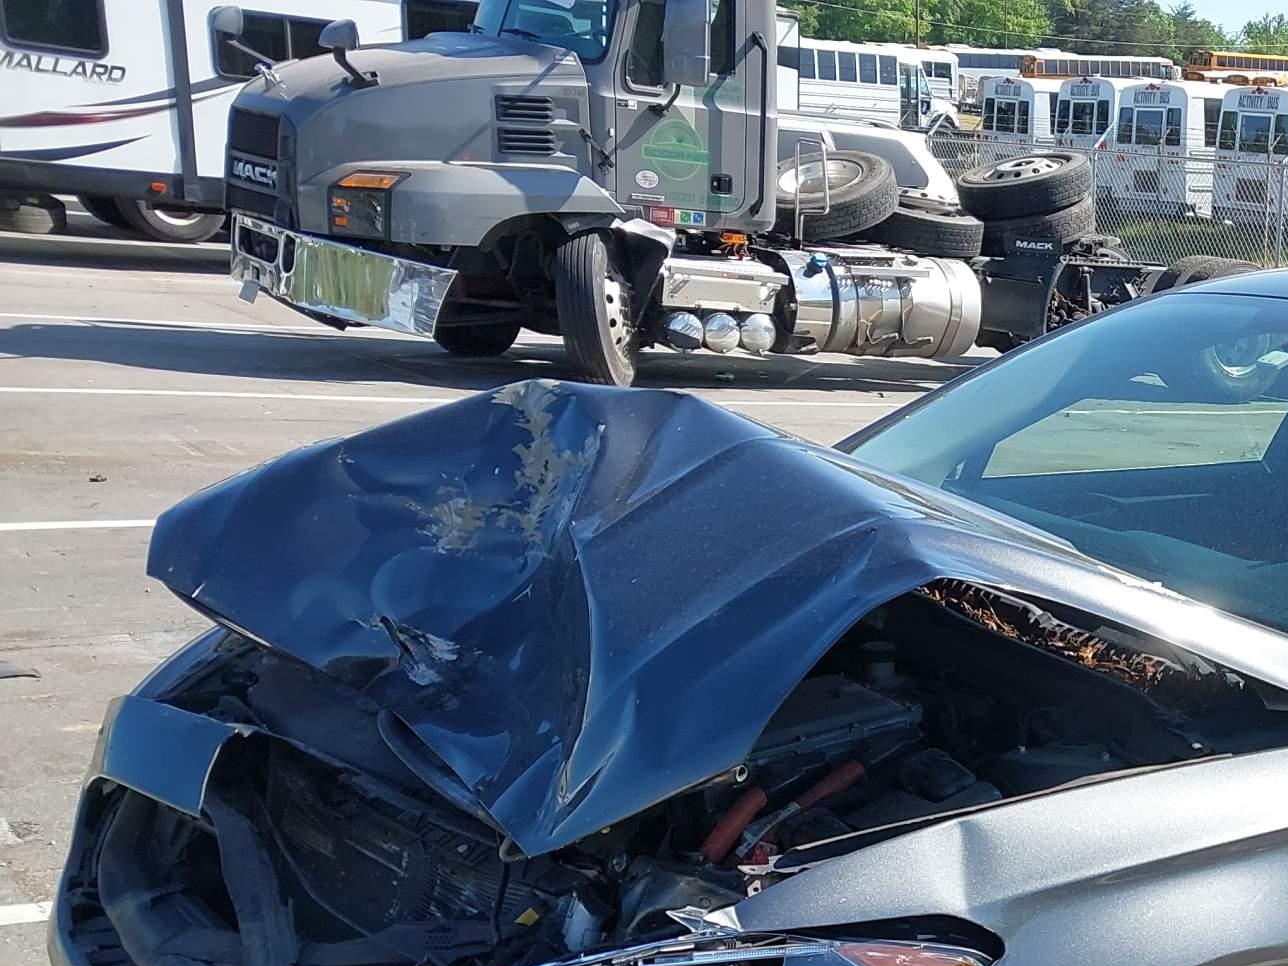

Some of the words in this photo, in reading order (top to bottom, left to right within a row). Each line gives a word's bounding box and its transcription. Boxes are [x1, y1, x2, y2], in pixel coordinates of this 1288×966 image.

[1133, 91, 1157, 103] ACTIVITY
[1159, 91, 1171, 104] BUS
[1237, 94, 1264, 108] ACTIVITY
[1266, 96, 1280, 110] BUS
[232, 160, 277, 184] MACK
[1015, 239, 1054, 250] MACK
